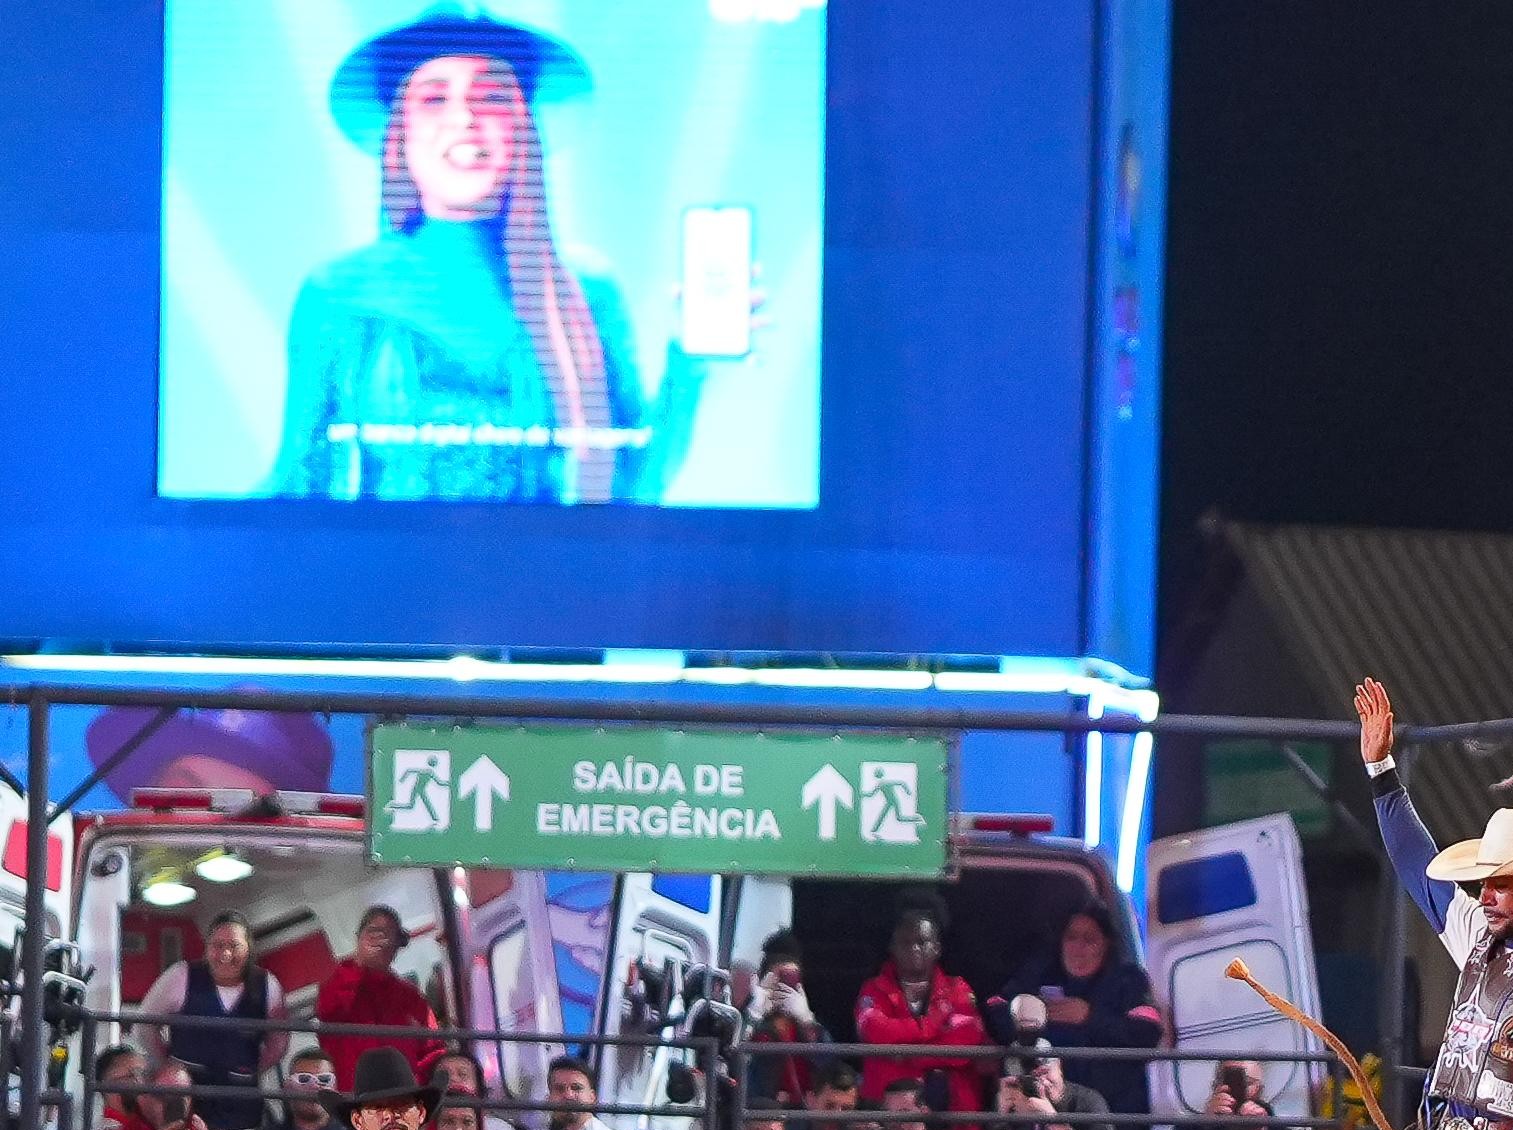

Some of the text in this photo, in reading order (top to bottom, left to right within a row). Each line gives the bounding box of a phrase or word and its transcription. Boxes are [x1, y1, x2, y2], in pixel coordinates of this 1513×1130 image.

[573, 754, 745, 796] SAÍDA DE
[536, 800, 783, 841] EMERGÊNCIA
